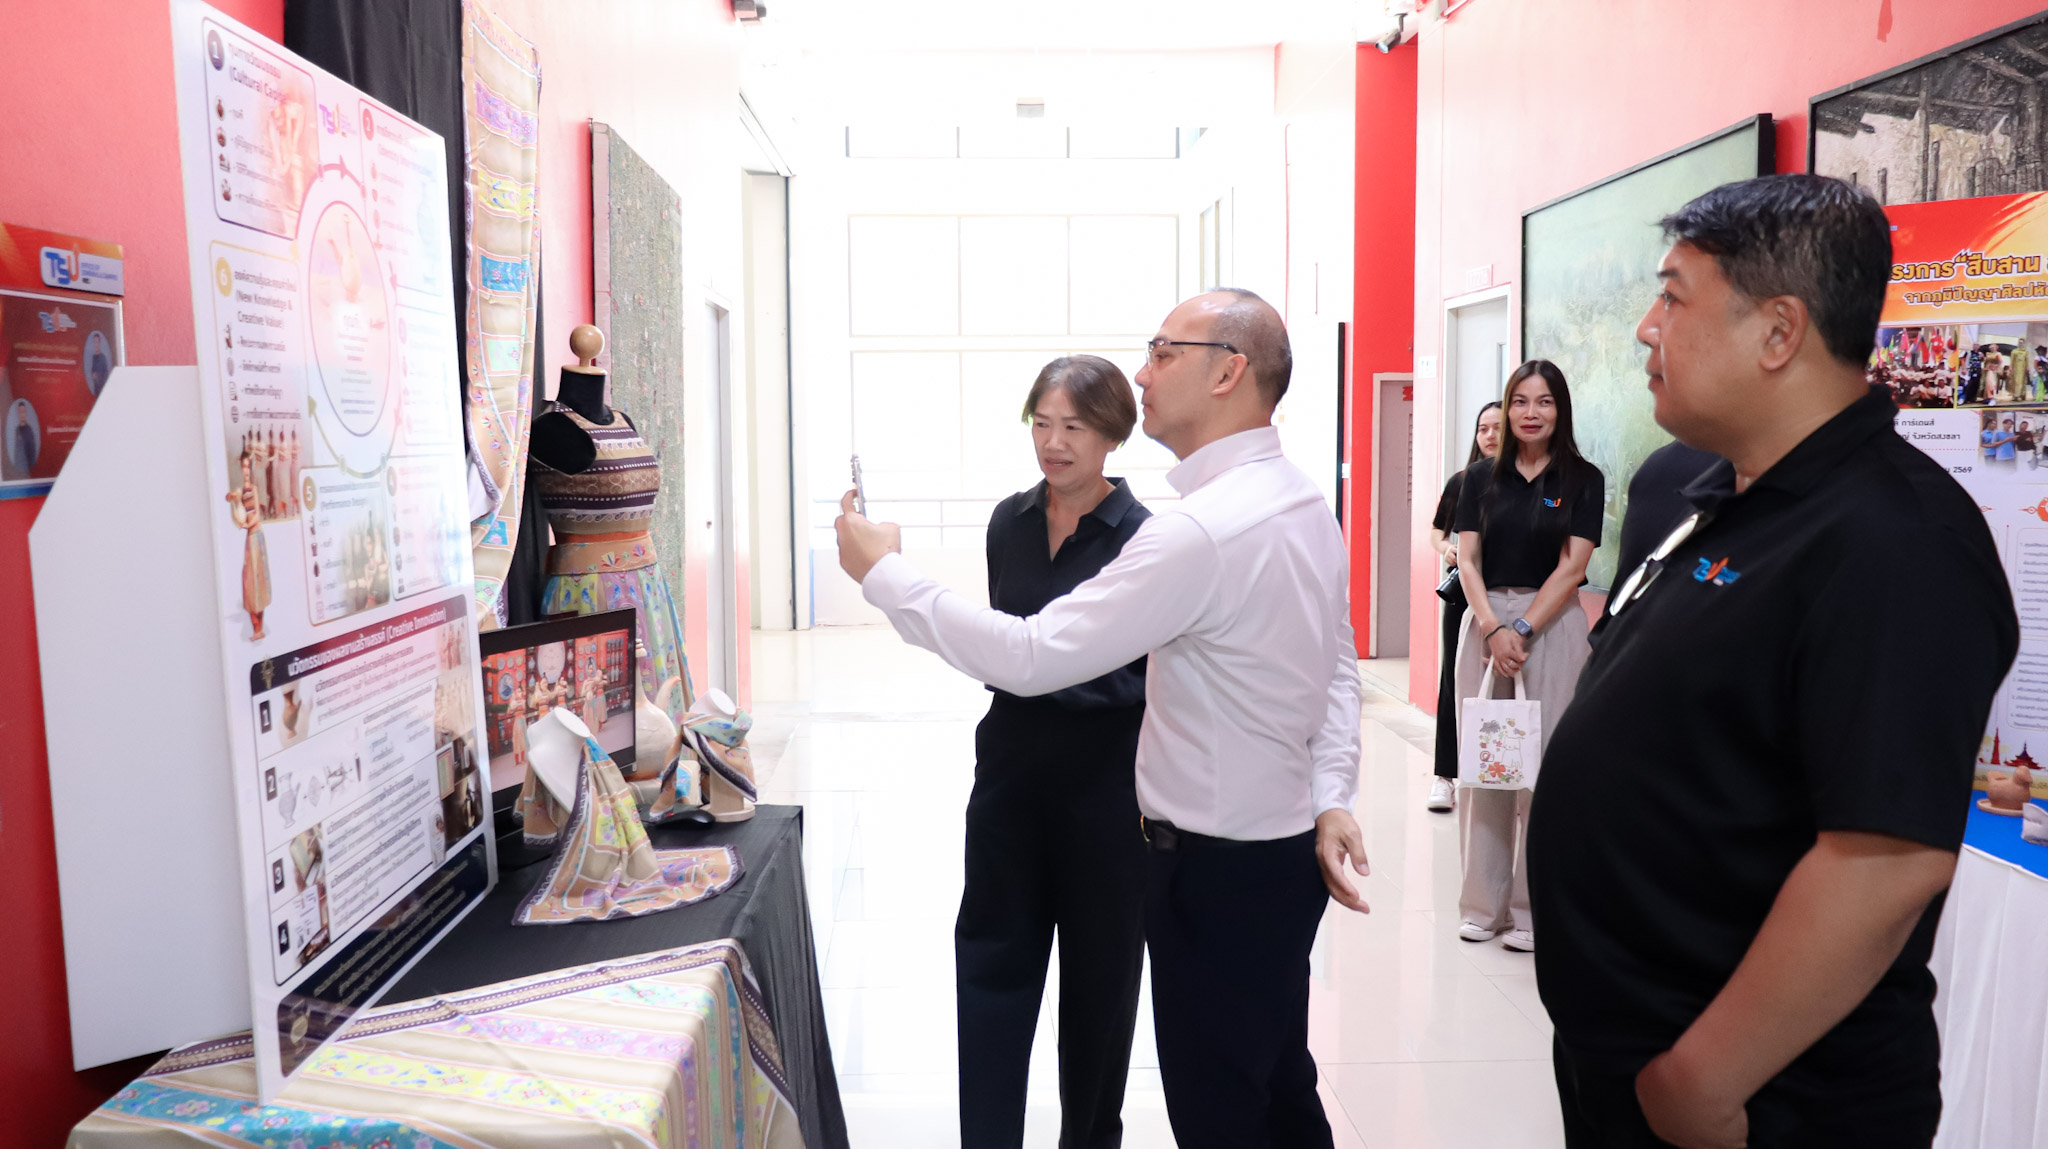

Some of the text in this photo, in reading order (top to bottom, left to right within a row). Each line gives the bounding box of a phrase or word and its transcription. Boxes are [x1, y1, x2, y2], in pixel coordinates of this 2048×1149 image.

[212, 40, 218, 59] 1
[45, 243, 79, 284] TSU
[1889, 261, 1955, 281] รงการ
[220, 268, 228, 286] 6
[235, 289, 253, 304] (New
[254, 293, 287, 311] Knowledge
[237, 310, 264, 325] Creative
[1912, 432, 1961, 440] จังหวัดสงขลา
[1952, 466, 1973, 474] 2569
[306, 485, 313, 502] 5
[1543, 497, 1562, 508] TSU
[387, 618, 414, 643] (Creative
[414, 608, 447, 634] Innovation)
[263, 708, 268, 725] 1
[268, 774, 274, 793] 2
[275, 866, 281, 886] 3
[280, 926, 287, 948] 4
